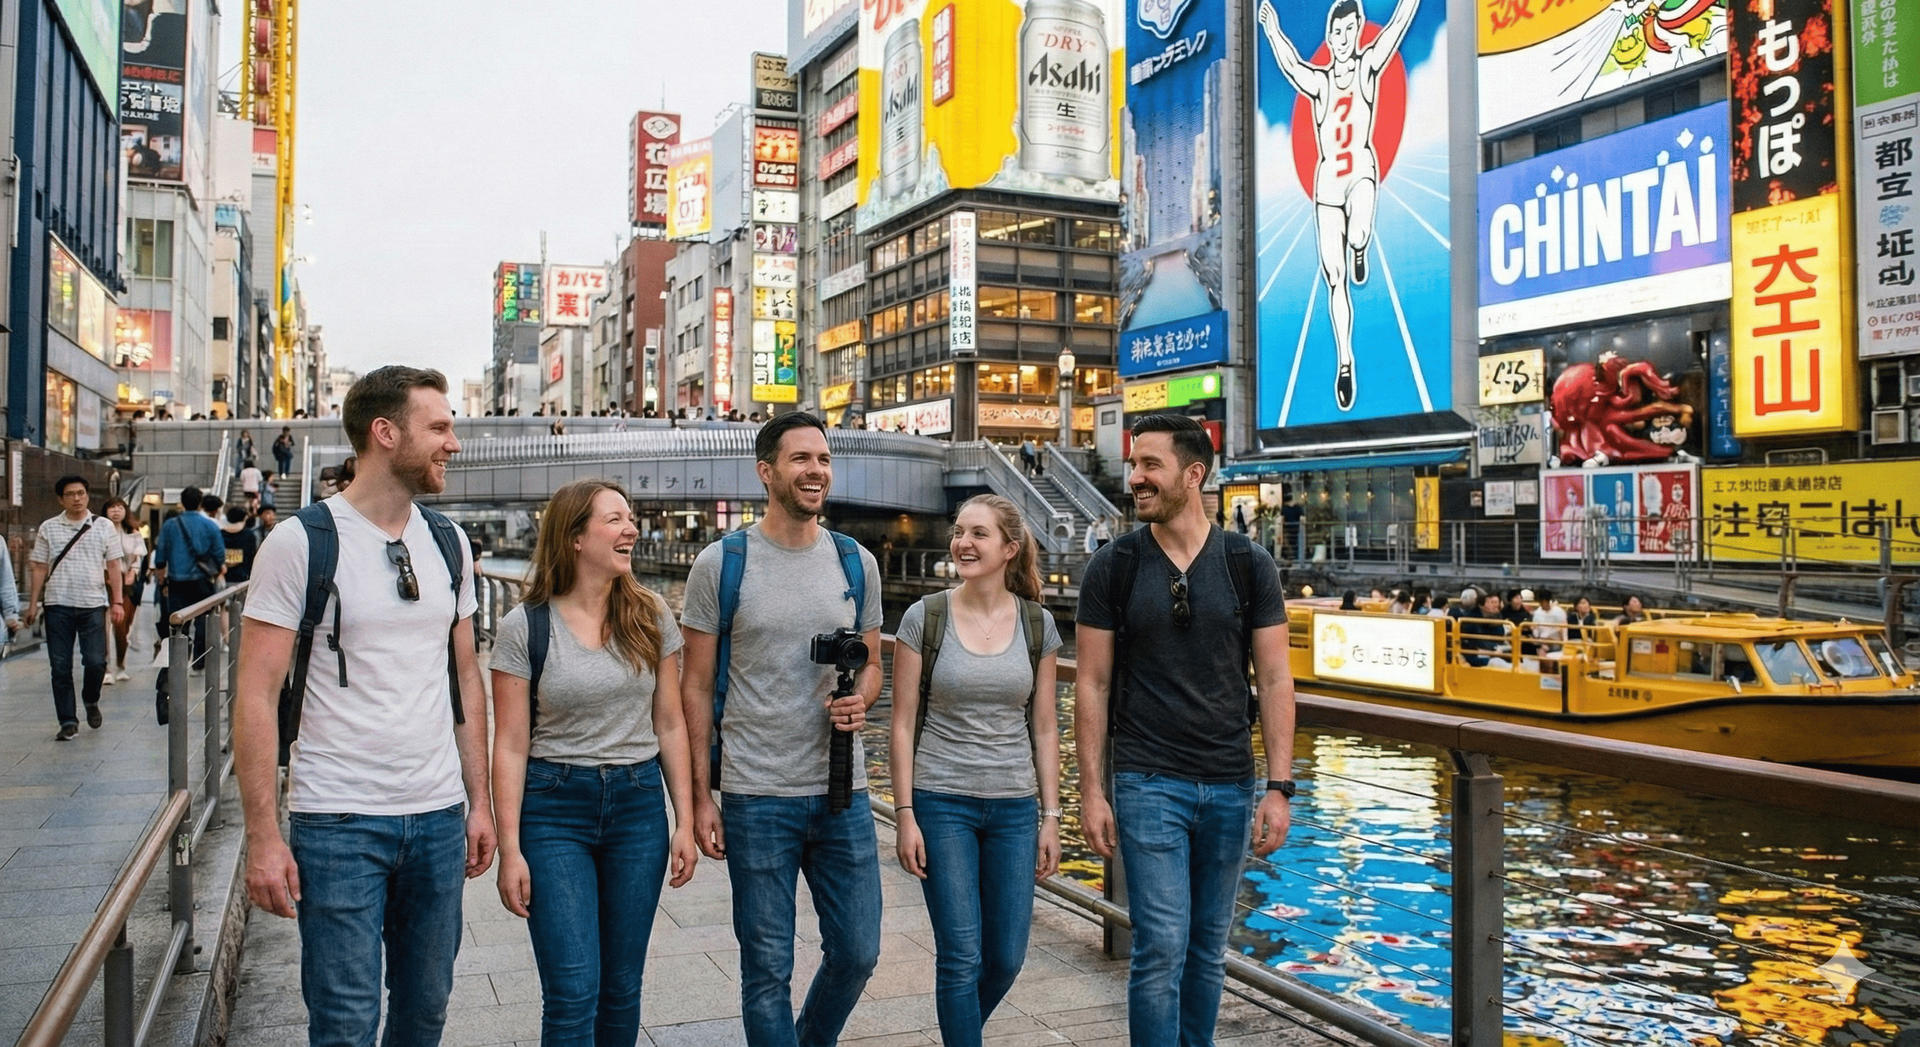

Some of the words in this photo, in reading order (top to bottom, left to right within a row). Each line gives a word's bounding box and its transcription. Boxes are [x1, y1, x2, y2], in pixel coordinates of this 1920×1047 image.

[1045, 33, 1086, 53] DRY
[1029, 52, 1100, 95] Asahi
[1057, 102, 1077, 118] 生
[1489, 136, 1718, 287] CHINTAI
